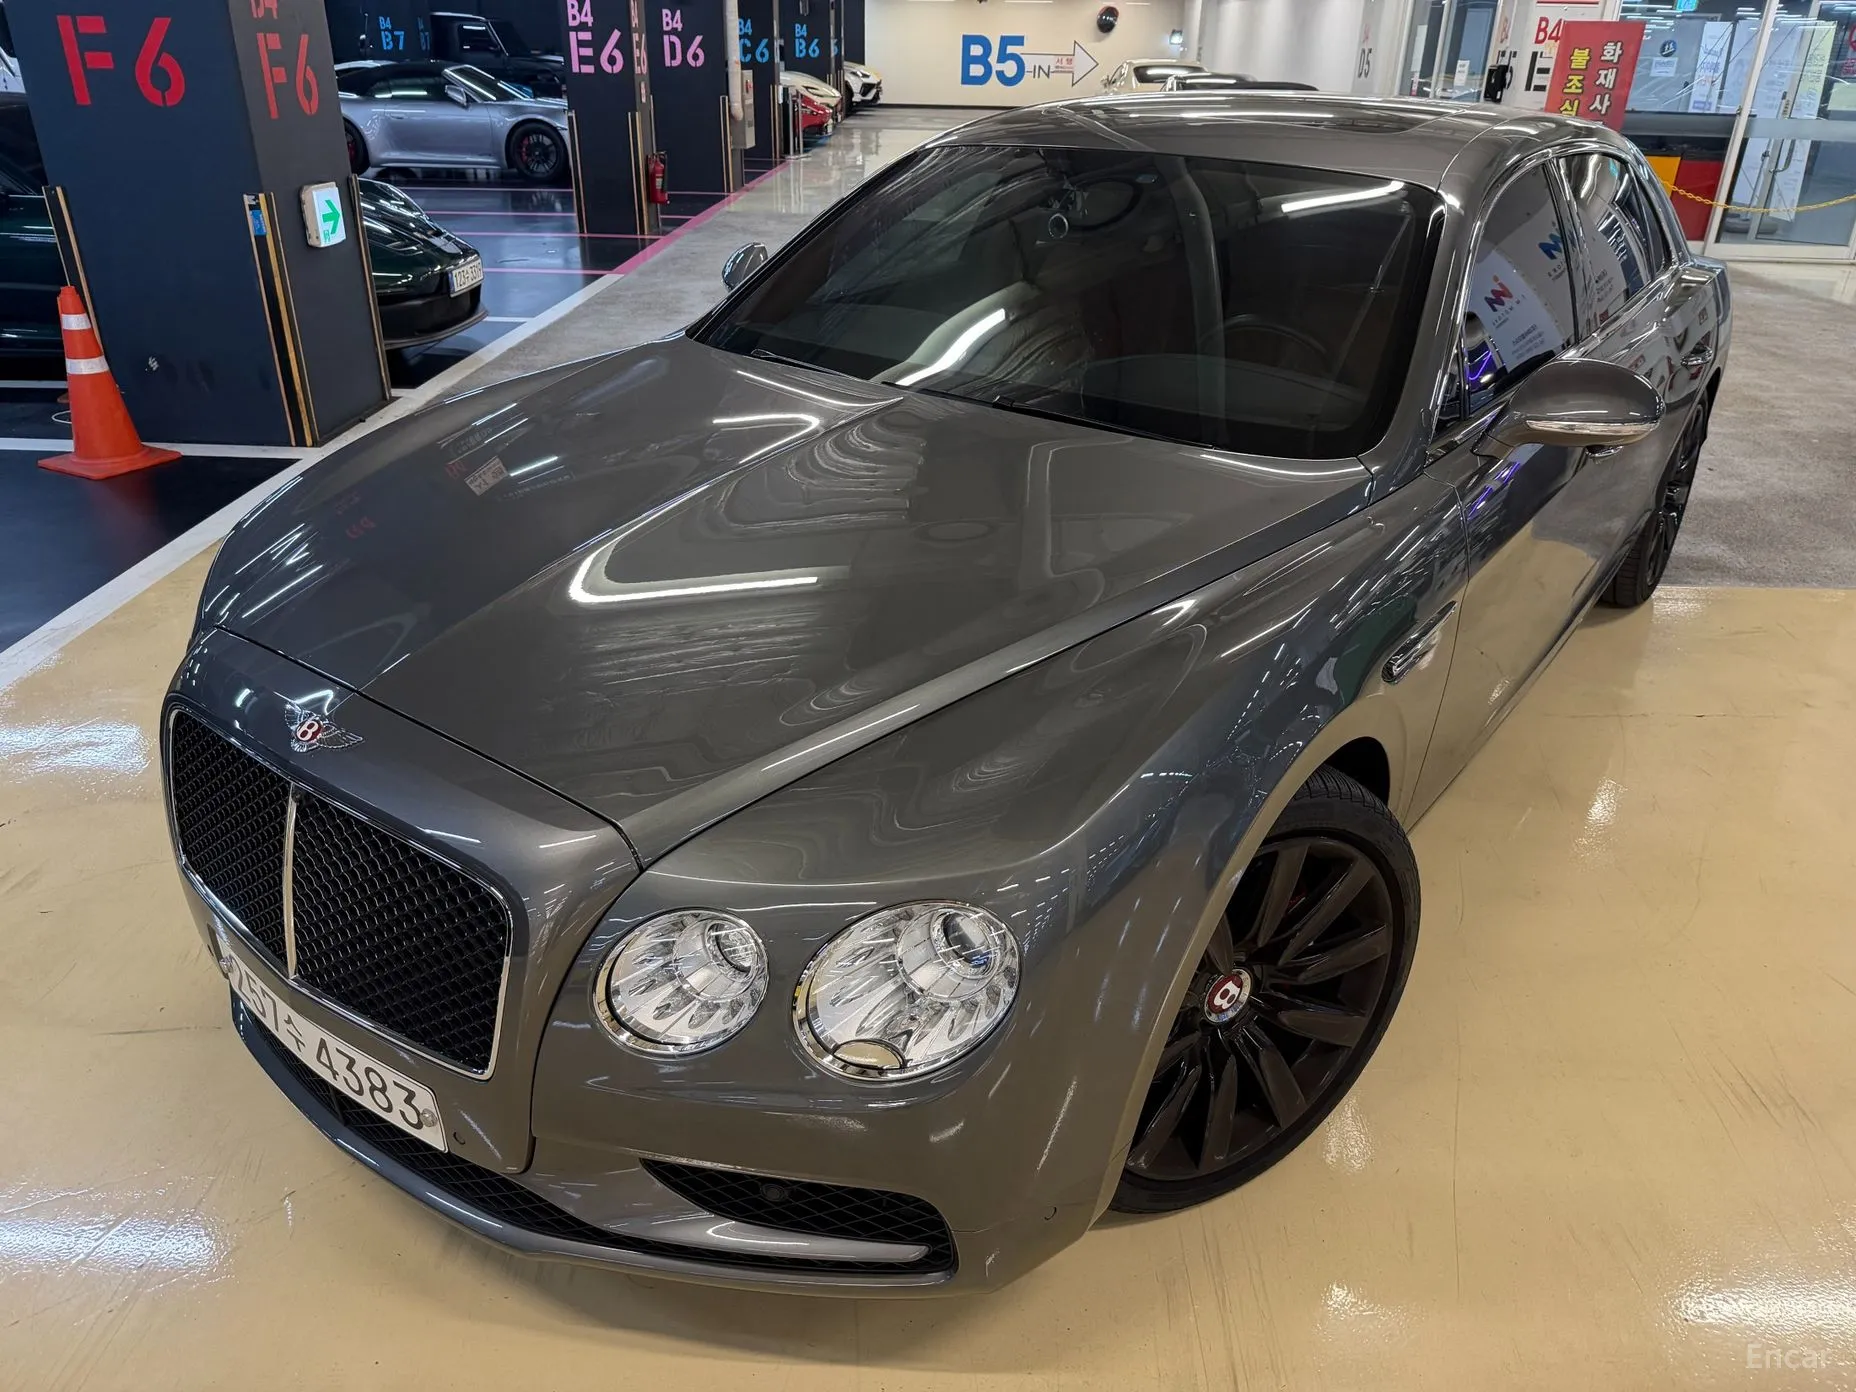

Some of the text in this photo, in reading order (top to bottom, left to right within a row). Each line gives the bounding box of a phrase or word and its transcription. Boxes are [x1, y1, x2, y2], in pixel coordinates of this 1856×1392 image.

[379, 16, 392, 29] B4
[567, 0, 593, 27] B4
[662, 9, 683, 31] B4
[738, 19, 752, 35] B4
[795, 24, 807, 37] B4
[1534, 16, 1562, 44] B4
[381, 31, 405, 50] B7
[569, 29, 624, 74] E6
[663, 35, 705, 67] D6
[739, 39, 769, 62] C6
[795, 39, 819, 58] B6
[961, 34, 1026, 87] B5
[1033, 64, 1050, 79] IN
[1358, 47, 1373, 78] D5
[316, 1036, 424, 1131] 4383
